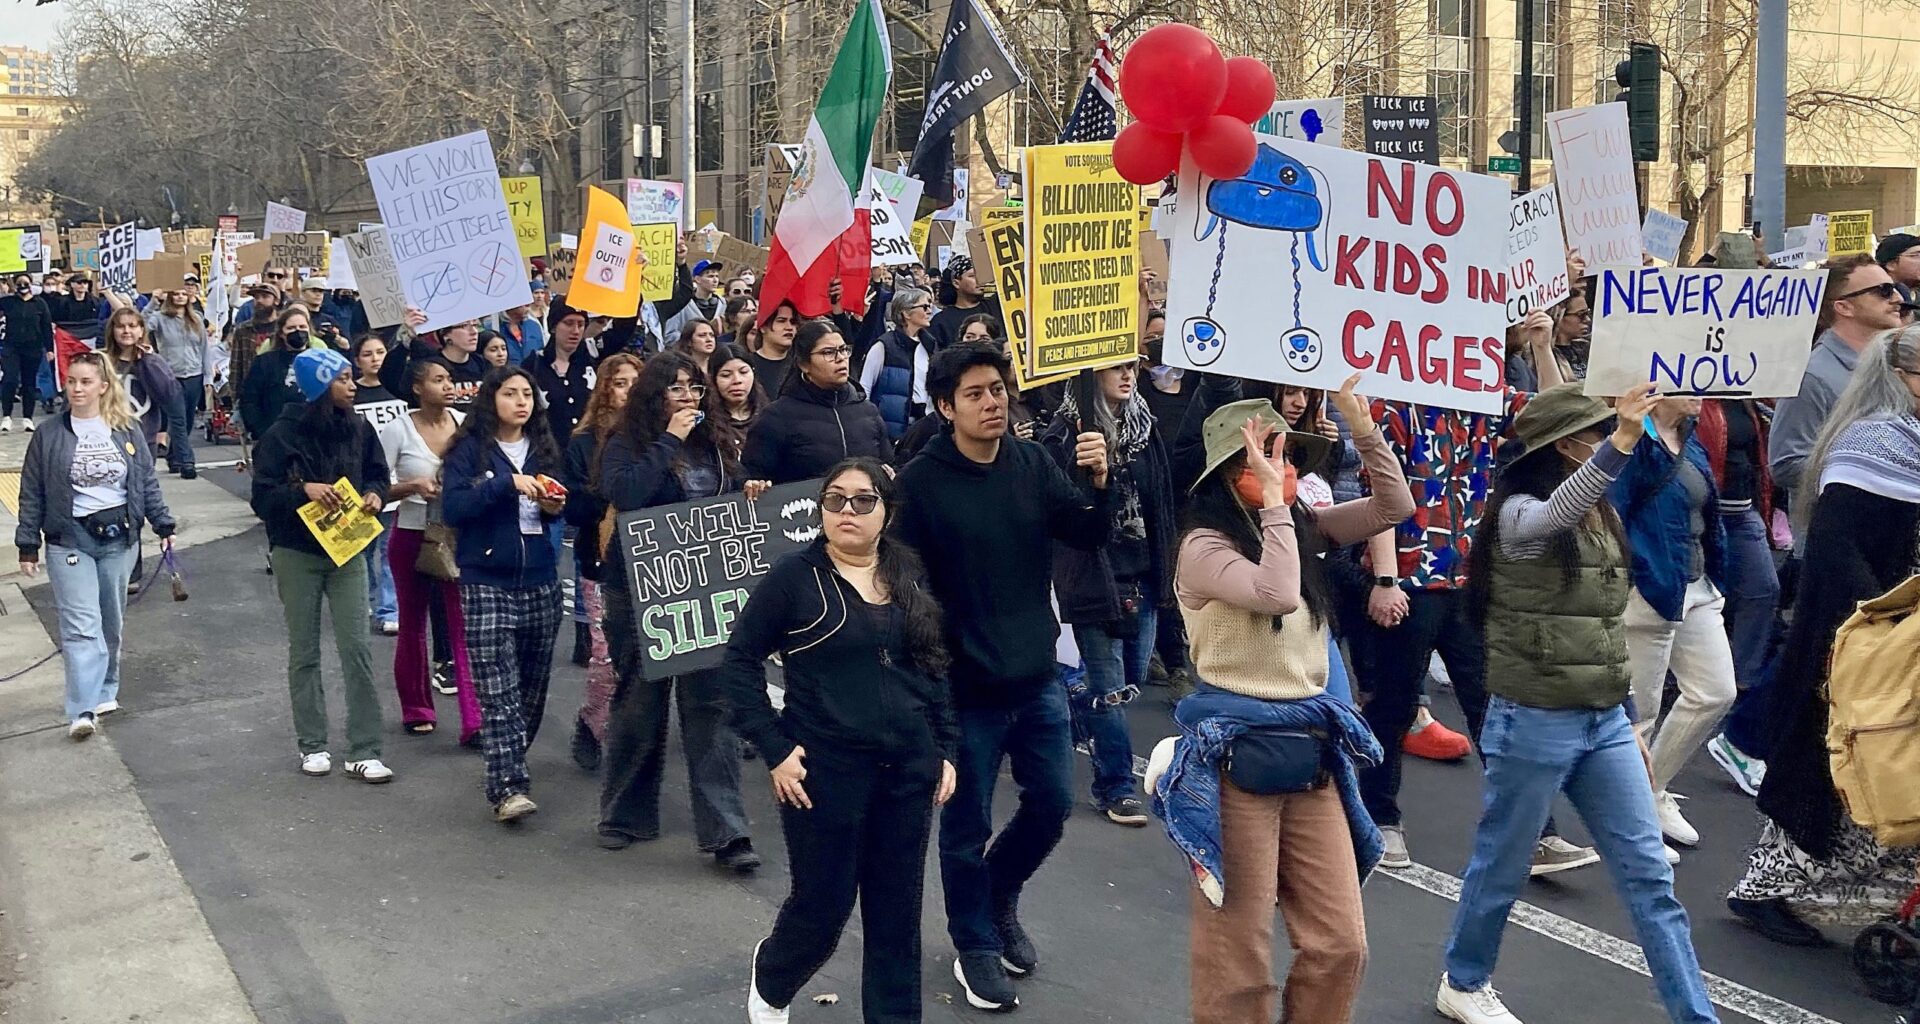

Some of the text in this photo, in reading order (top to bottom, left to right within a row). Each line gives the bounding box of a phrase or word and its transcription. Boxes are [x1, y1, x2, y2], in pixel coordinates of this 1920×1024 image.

[1373, 97, 1426, 112] FUCK ICE
[1375, 141, 1424, 153] FUCK ICE
[378, 154, 424, 189] WE
[1064, 155, 1082, 167] VOTE
[381, 175, 499, 228] LET HISTORY
[509, 182, 528, 194] UP
[1042, 182, 1134, 217] BILLIONAIRES
[1367, 158, 1465, 237] NO
[509, 200, 532, 216] TY
[1831, 213, 1870, 222] ARREST
[99, 225, 133, 249] ICE
[285, 233, 307, 244] NO
[390, 209, 508, 260] REPEAT ITSELF
[608, 233, 624, 247] ICE
[639, 229, 673, 247] ACH
[1042, 218, 1133, 255] SUPPORT ICE
[1508, 225, 1539, 256] EEDS
[1833, 222, 1869, 237] JONATHAN
[101, 244, 134, 268] OUT
[271, 244, 323, 257] PEDOPHILE
[348, 230, 385, 259] WE
[1834, 237, 1853, 251] ROSS
[1853, 236, 1866, 250] FOR
[275, 257, 289, 268] IN
[595, 250, 626, 268] OUT!!!
[1039, 254, 1134, 286] WORKERS NEED AN
[1334, 235, 1507, 306] KIDS IN
[101, 260, 135, 287] NOW!
[641, 275, 673, 292] RUMP
[1506, 258, 1538, 292] UR
[1053, 283, 1121, 312] INDEPENDENT
[1602, 268, 1824, 322] NEVER AGAIN
[1045, 311, 1098, 340] SOCIALIST
[1099, 307, 1130, 332] PARTY
[1045, 339, 1115, 363] PEACE AND FREEDOM PARTY
[1341, 309, 1504, 393] CAGES
[1649, 352, 1758, 394] NOW
[628, 499, 771, 556] I WILL
[633, 534, 771, 603] NOT BE
